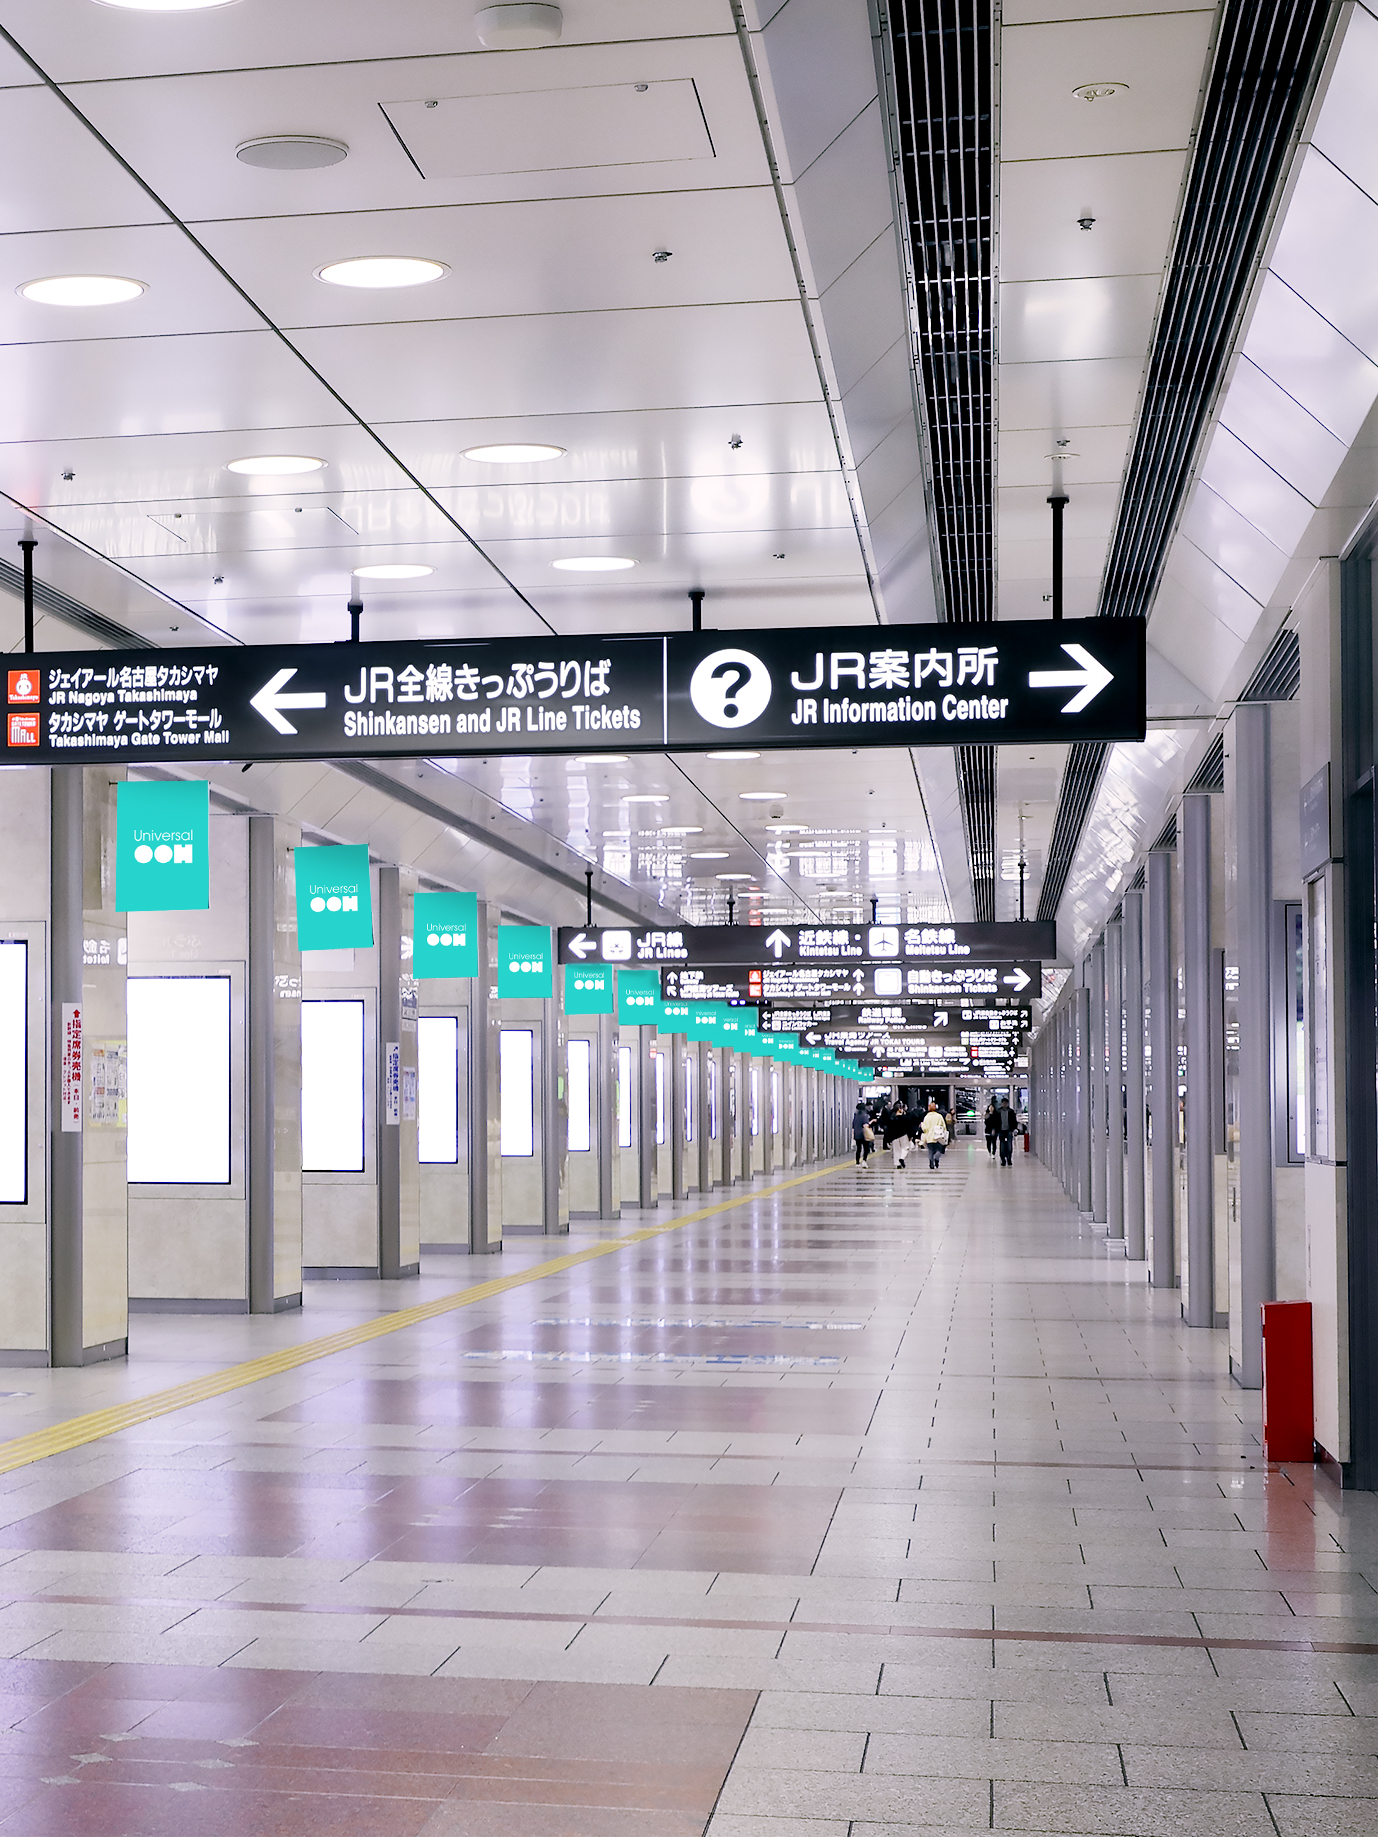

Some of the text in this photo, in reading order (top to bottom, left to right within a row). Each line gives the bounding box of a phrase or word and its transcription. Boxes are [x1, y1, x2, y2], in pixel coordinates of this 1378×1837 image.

[790, 646, 999, 691] JR案内所
[49, 664, 219, 690] ジェイアール名古屋タカシマヤ
[344, 658, 612, 705] JR全線きっぷうりば
[49, 688, 198, 706] JR Nagoya Takashimaya
[791, 693, 1009, 726] JR Information Center
[49, 708, 223, 733] タカシマヤ ゲートタワーモール
[344, 703, 641, 737] Shinkansen and JR Line Tickets
[49, 730, 230, 748] Takashimaya Gate Tower Mall
[134, 829, 194, 842] Universal
[134, 844, 193, 864] OOH
[309, 884, 359, 894] Universal
[310, 896, 359, 913] OOH
[426, 923, 467, 932] Universal
[426, 933, 467, 947] OOH
[508, 952, 544, 960] Universal
[944, 944, 971, 956] Line
[508, 961, 543, 973] OOH
[573, 971, 605, 979] Universal
[574, 980, 605, 991] OOH
[625, 988, 655, 996] Universal
[626, 996, 654, 1006] OOH
